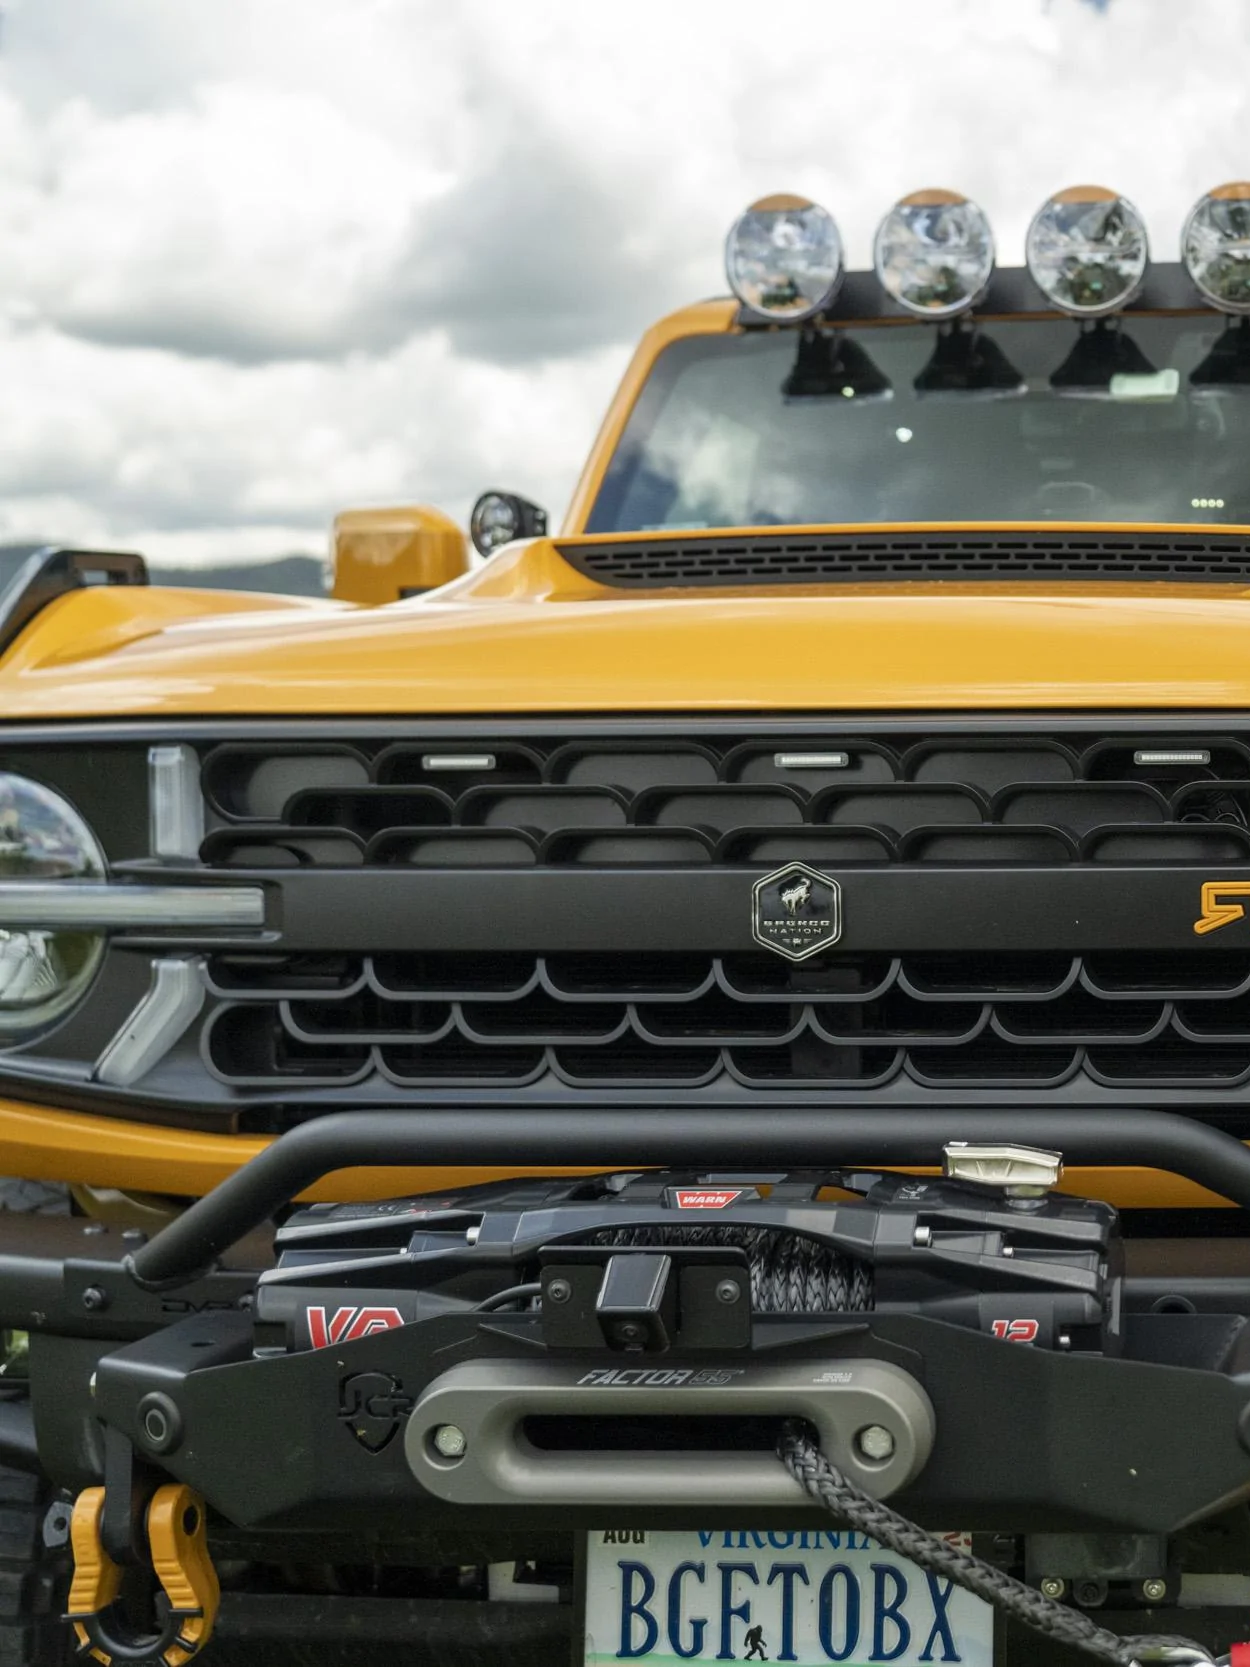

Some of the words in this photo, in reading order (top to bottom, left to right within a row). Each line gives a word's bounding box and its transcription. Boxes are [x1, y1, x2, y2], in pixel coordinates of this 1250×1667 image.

[682, 1196, 727, 1204] WARN
[992, 1319, 1039, 1342] 12
[576, 1369, 694, 1384] FACTOR
